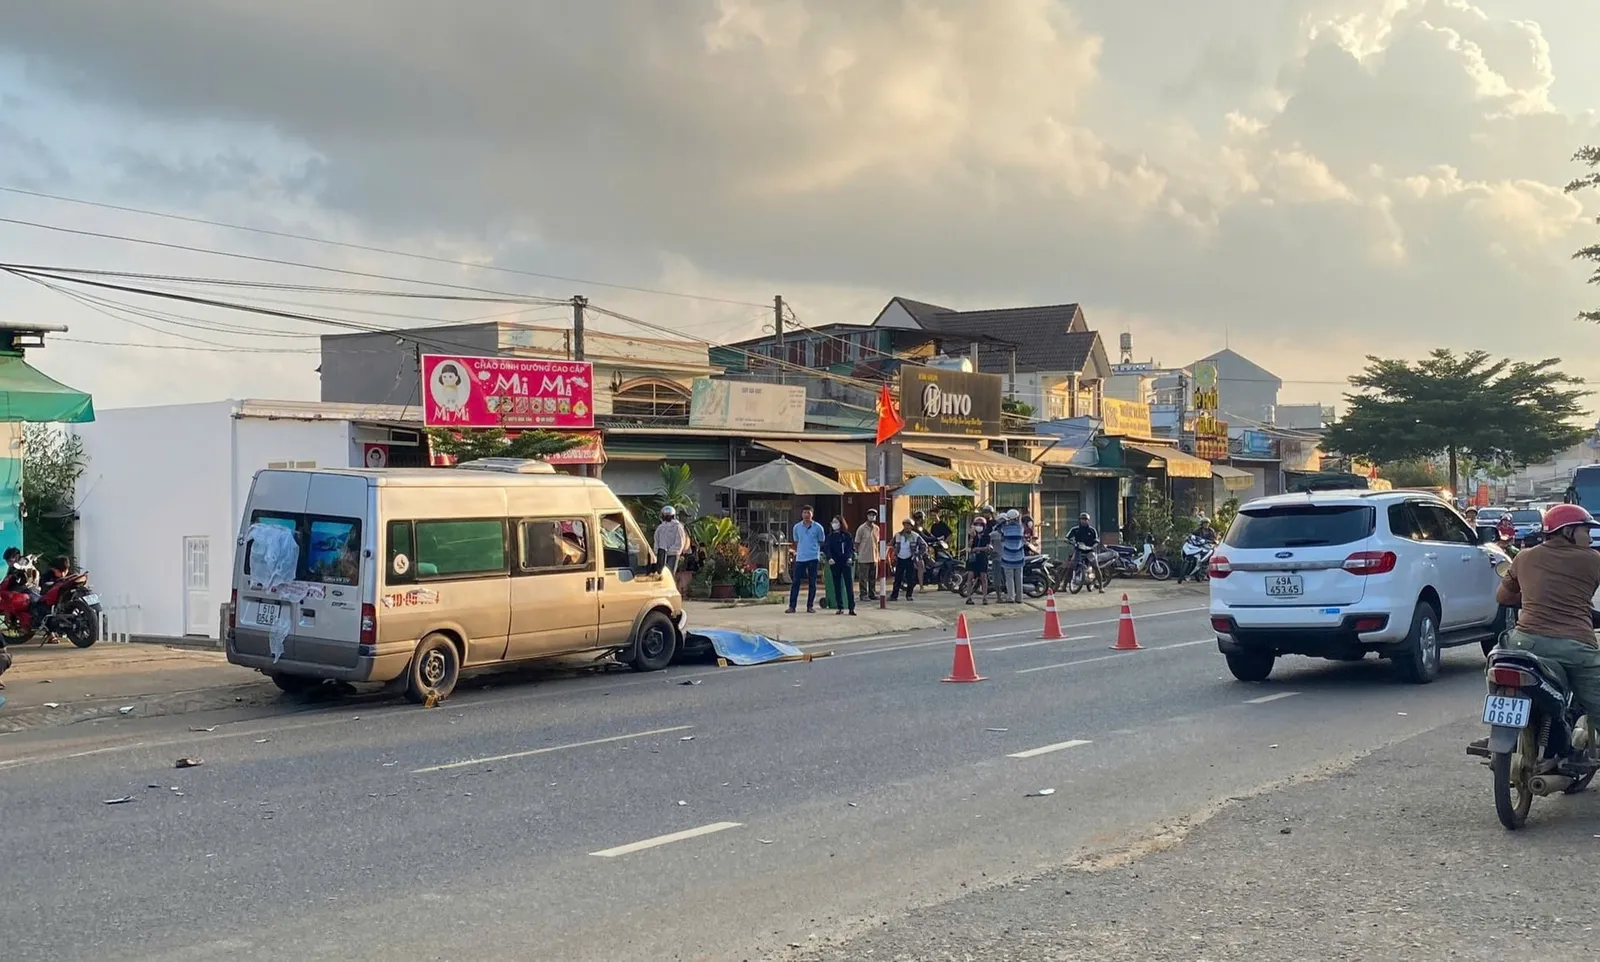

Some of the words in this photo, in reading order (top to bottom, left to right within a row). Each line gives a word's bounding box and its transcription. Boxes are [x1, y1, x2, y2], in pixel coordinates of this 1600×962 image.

[551, 365, 568, 373] CAO
[942, 392, 972, 416] HYO
[1275, 577, 1292, 586] 49A
[1270, 585, 1299, 594] 453.45
[257, 613, 277, 625] 054.8
[1491, 697, 1524, 712] 49-V1
[1488, 710, 1522, 725] 0668
